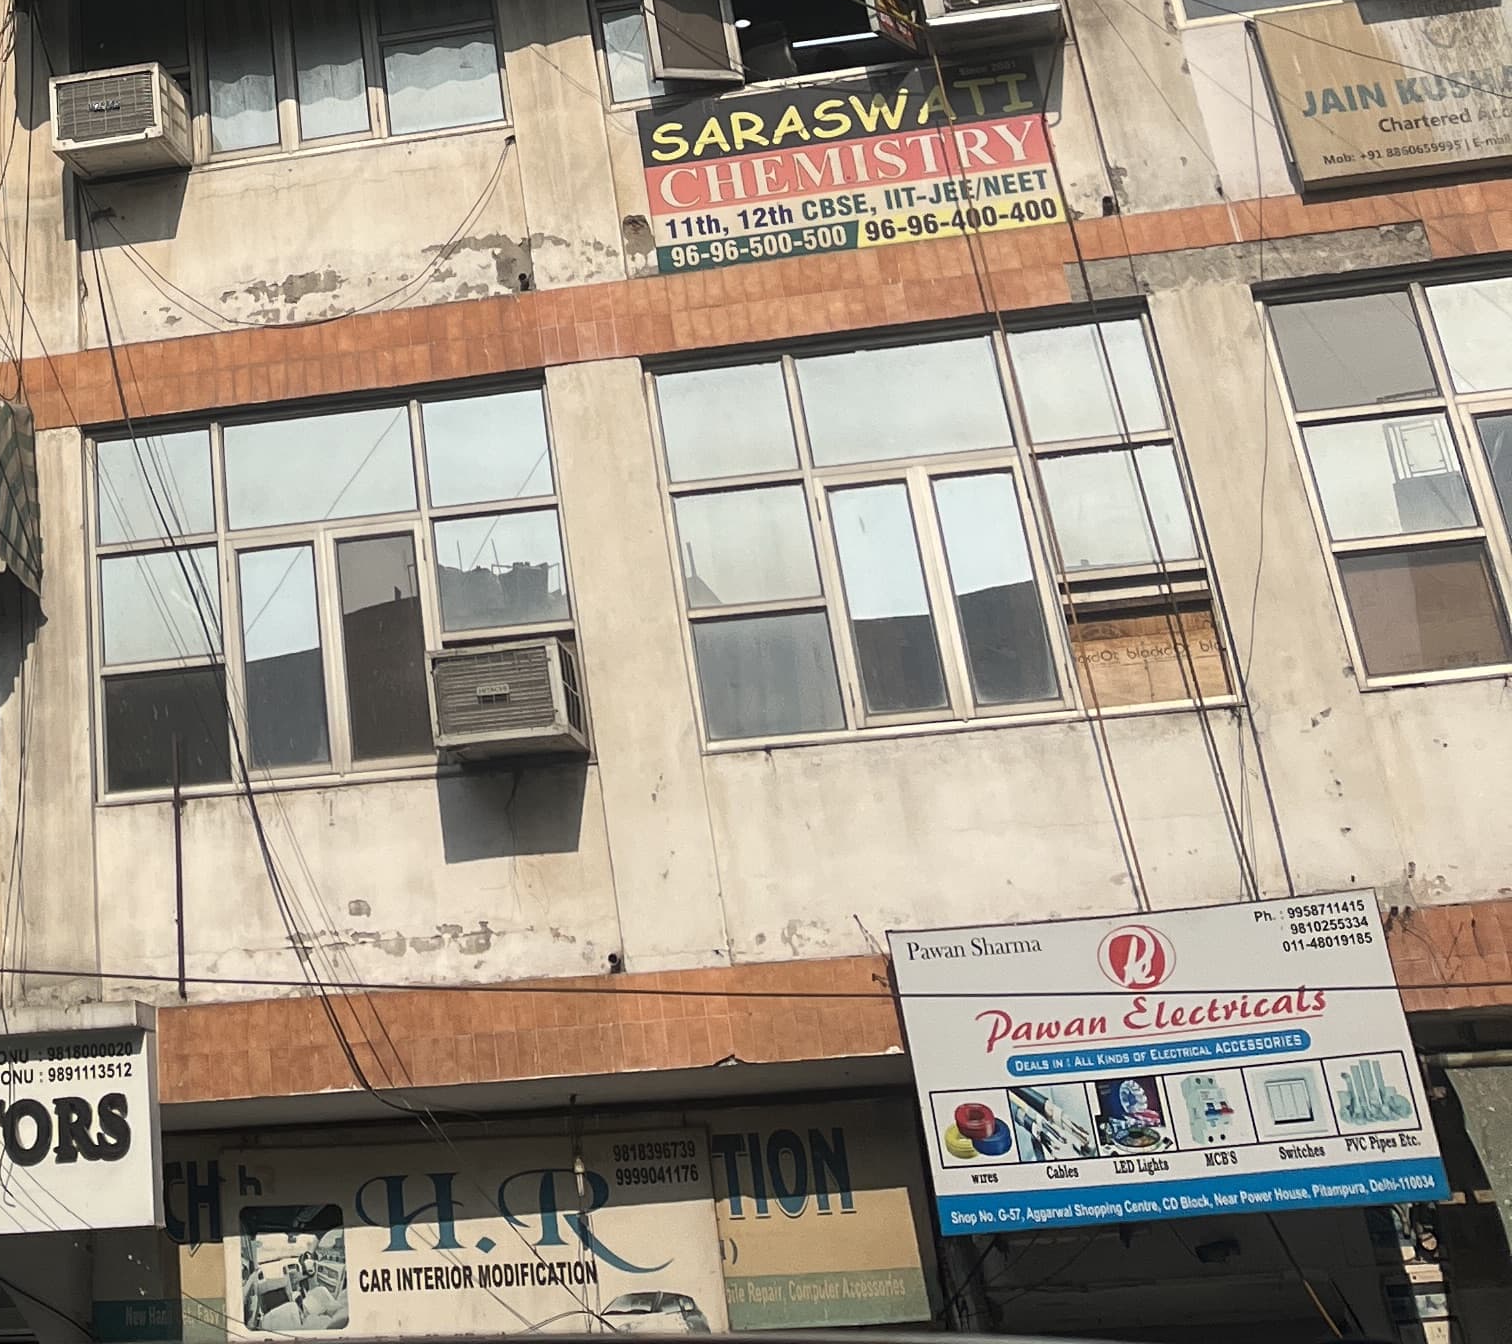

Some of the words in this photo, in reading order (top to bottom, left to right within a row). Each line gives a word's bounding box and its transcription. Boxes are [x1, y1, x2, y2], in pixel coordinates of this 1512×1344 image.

[1302, 81, 1387, 118] JAIN
[651, 73, 1034, 162] SARASWATI
[1379, 108, 1472, 132] Chartered
[659, 120, 1031, 209] CHEMISTRY
[665, 214, 730, 239] 11th,
[737, 205, 794, 232] 12th
[803, 194, 877, 220] CBSE,
[884, 169, 1048, 211] IIT-JEE/NEET
[671, 225, 847, 268] 96-96-500-500
[865, 197, 1057, 242] 96-96-400-400
[906, 941, 966, 961] Pawan
[971, 935, 1042, 957] Sharma
[1287, 900, 1365, 920] 9958711415
[1290, 916, 1368, 935] 9810255334
[1282, 932, 1373, 953] 011-48019185
[975, 1009, 1107, 1053] Pawan
[1123, 985, 1326, 1030] Electricals
[47, 1041, 133, 1061] 9818000020
[1215, 1035, 1302, 1053] ACCESSORIES
[48, 1063, 132, 1082] 9891113512
[613, 1140, 696, 1162] 9818396739
[971, 1172, 999, 1184] wires
[1046, 1165, 1079, 1180] Cables
[1114, 1159, 1135, 1174] LED
[1138, 1158, 1170, 1175] Lights
[1279, 1144, 1326, 1160] Switches
[1345, 1137, 1367, 1152] PVC
[1369, 1134, 1397, 1153] Pipes
[1399, 1133, 1422, 1148] Etc.
[615, 1164, 699, 1187] 9999041176
[951, 1210, 978, 1226] Shop
[1027, 1204, 1072, 1223] Aggarwal
[1074, 1200, 1122, 1218] Shopping
[1312, 1182, 1369, 1199] Pitampura,
[1369, 1175, 1435, 1193] Delhi-110034
[359, 1268, 391, 1293] CAR
[397, 1265, 474, 1291] INTERIOR
[478, 1260, 599, 1288] MODIFICATION
[788, 1280, 839, 1304] Computer
[843, 1275, 906, 1297] Accessories
